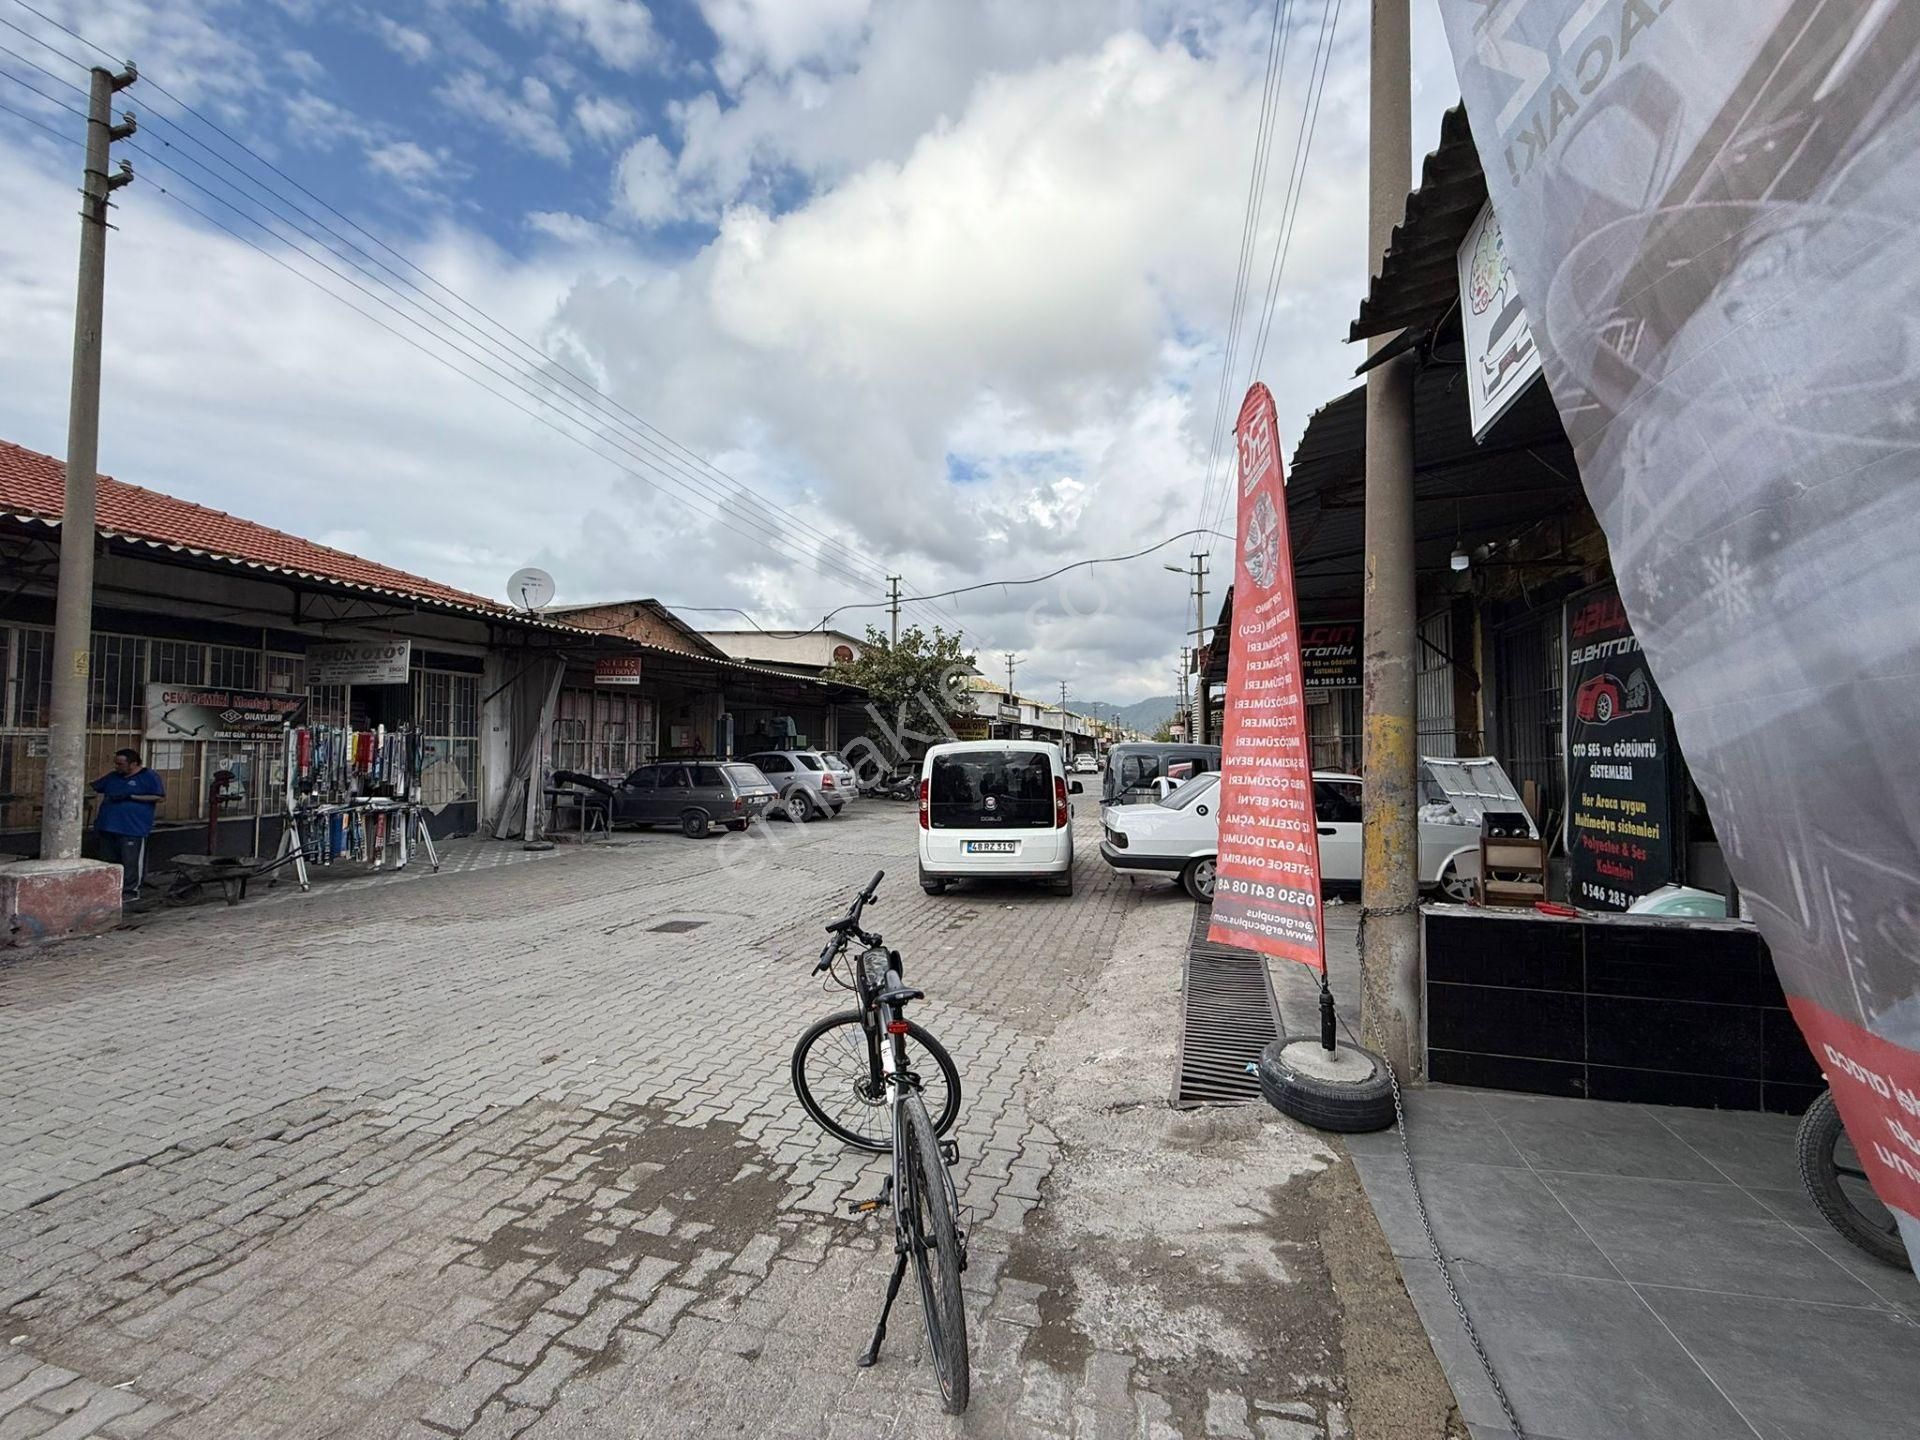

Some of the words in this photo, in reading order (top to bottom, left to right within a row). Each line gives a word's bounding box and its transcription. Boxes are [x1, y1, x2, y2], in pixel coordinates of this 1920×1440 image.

[361, 645, 396, 660] OTO
[1573, 743, 1586, 757] OTO
[1587, 743, 1601, 757] SES
[1602, 746, 1612, 757] ve
[1613, 738, 1657, 758] GÖRÜNTÜ
[1590, 761, 1633, 780] SİSTEMLERİ
[1582, 792, 1594, 807] Her
[1596, 794, 1618, 809] Araca
[1620, 800, 1647, 816] uygun
[1617, 818, 1660, 839] sistemleri
[1631, 844, 1648, 861] Ses
[1581, 881, 1588, 896] 0
[1588, 883, 1606, 901] 546
[1607, 889, 1627, 907] 285
